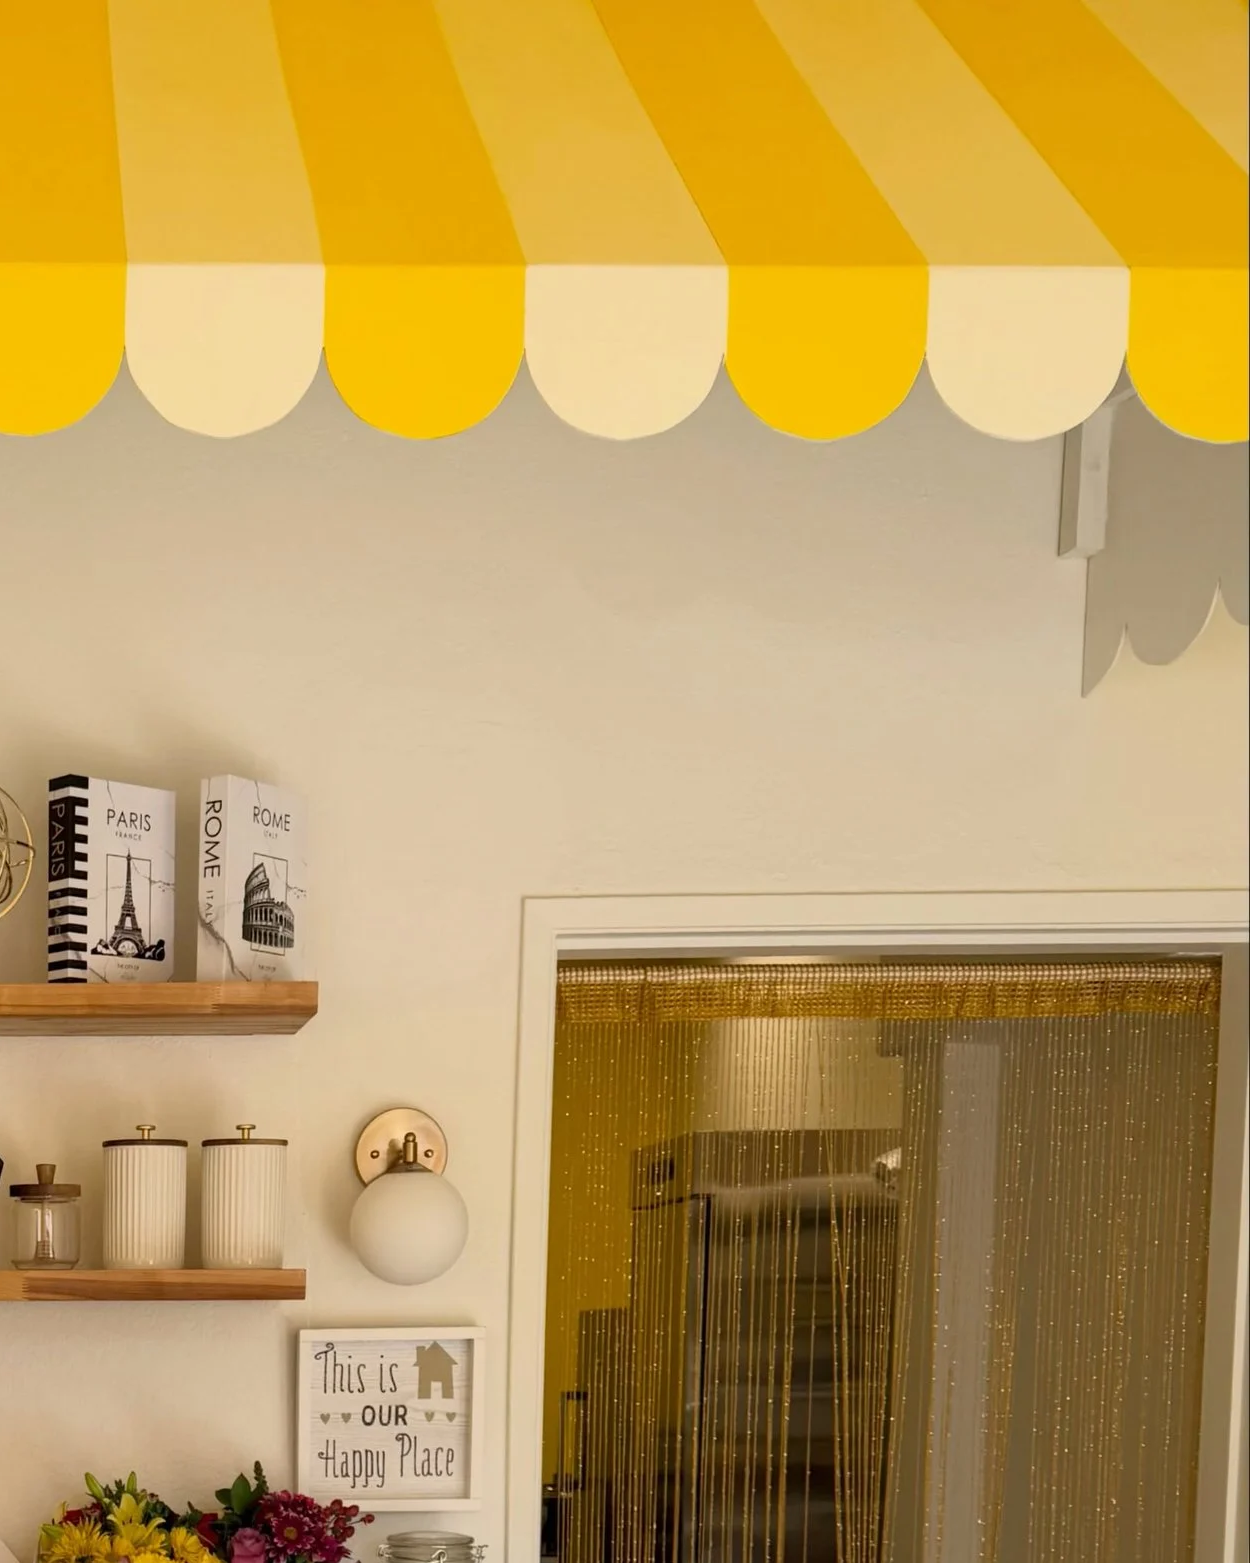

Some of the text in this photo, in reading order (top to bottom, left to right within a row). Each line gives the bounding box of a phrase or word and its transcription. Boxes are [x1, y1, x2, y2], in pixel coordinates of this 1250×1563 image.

[51, 803, 66, 877] PARIS
[106, 808, 152, 832] PARIS
[204, 800, 223, 878] ROME
[253, 805, 291, 832] ROME
[314, 1342, 399, 1394] This is
[361, 1404, 408, 1426] OUR
[317, 1433, 455, 1489] Happy Place
